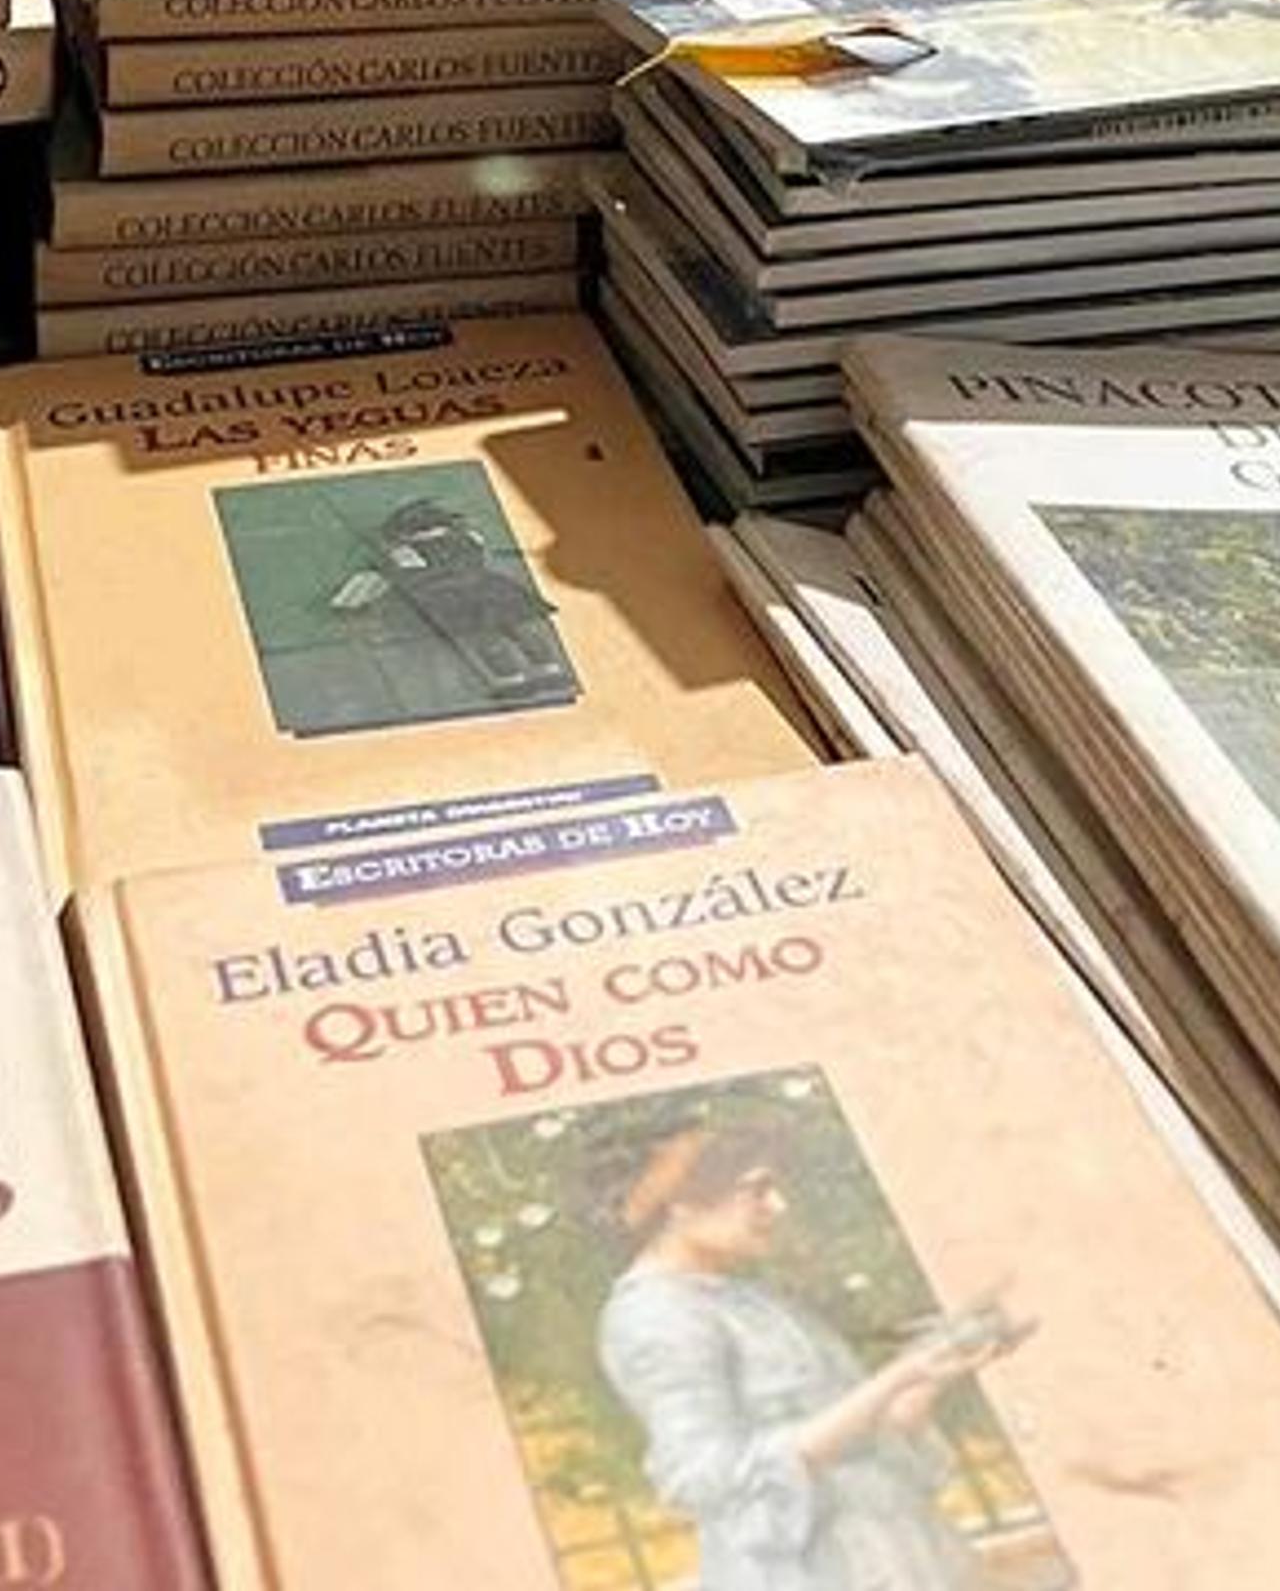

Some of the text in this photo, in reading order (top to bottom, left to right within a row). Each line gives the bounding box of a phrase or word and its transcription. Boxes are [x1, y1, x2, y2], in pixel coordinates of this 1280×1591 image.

[356, 52, 471, 86] CARLOS
[351, 120, 471, 154] CARLOS
[305, 203, 424, 235] CARLOS
[289, 246, 407, 283] CARLOS
[46, 353, 571, 433] Guadalupe Loaeza
[137, 395, 508, 454] LAS YEGUAS
[254, 434, 420, 474] FINAS
[296, 805, 717, 894] ESCRITORAS DE HOY
[211, 860, 867, 1005] Eladia González
[303, 935, 826, 1064] QUIEN COMO
[489, 1024, 702, 1099] DIOS
